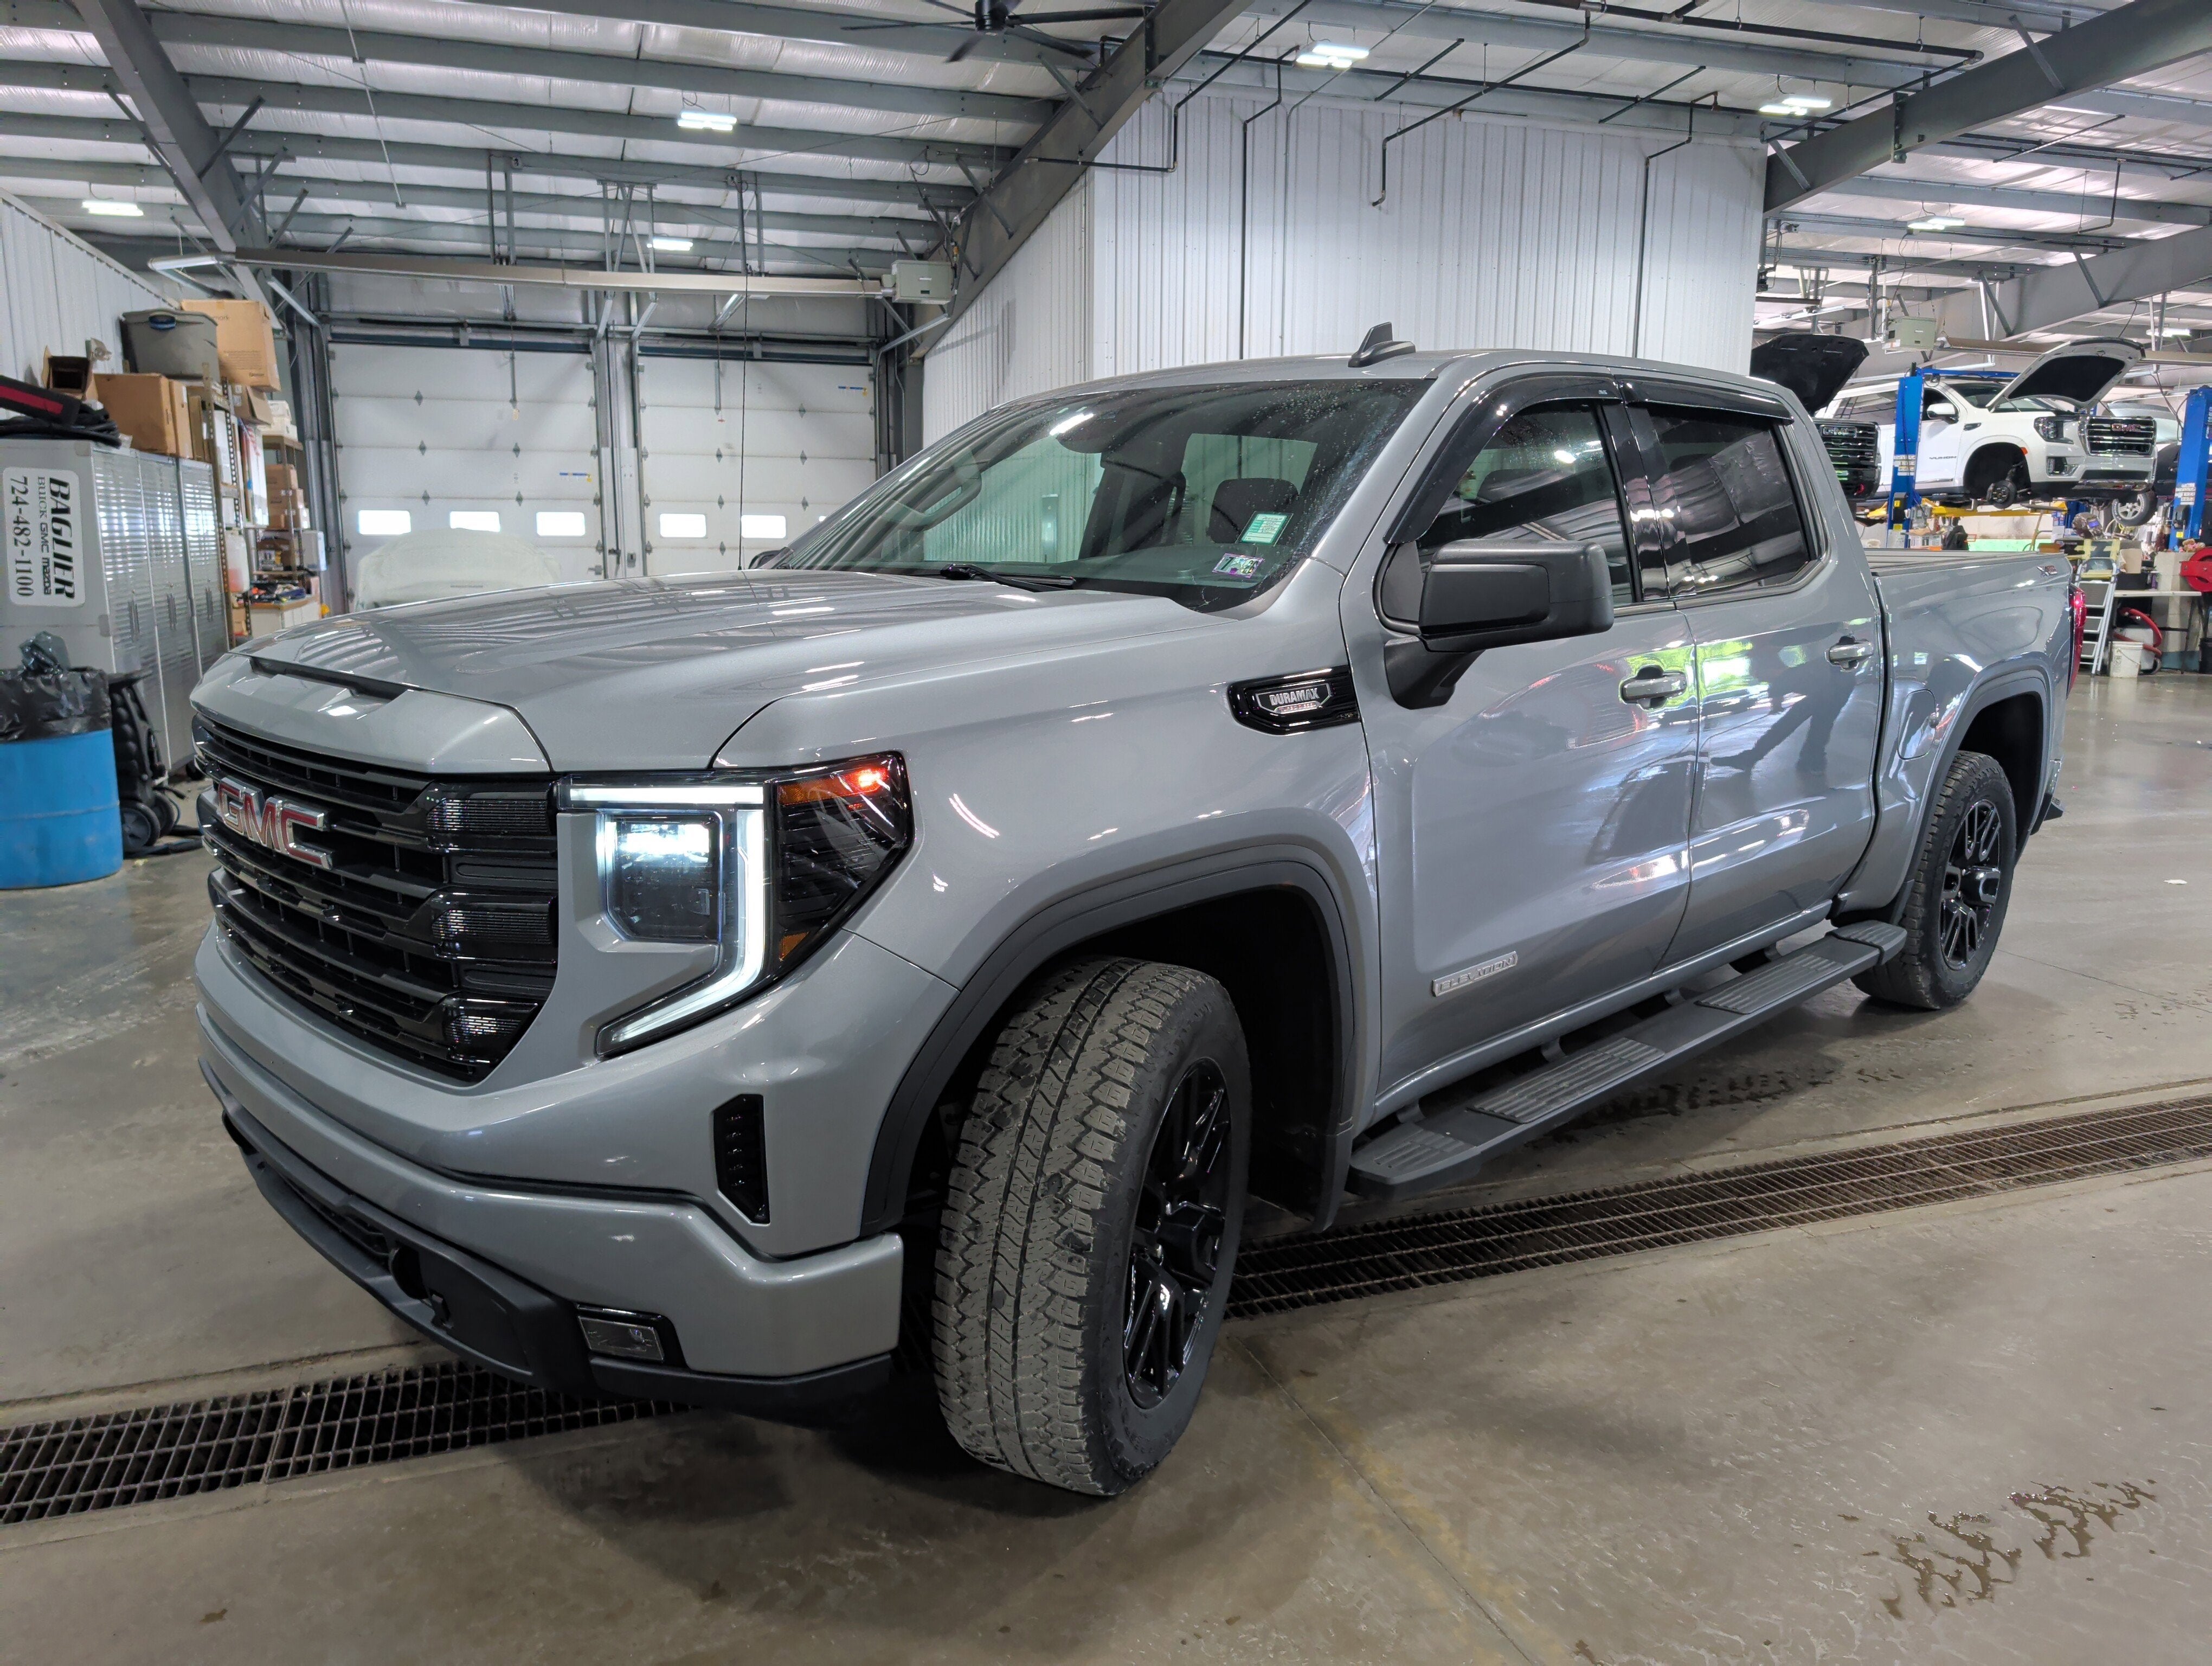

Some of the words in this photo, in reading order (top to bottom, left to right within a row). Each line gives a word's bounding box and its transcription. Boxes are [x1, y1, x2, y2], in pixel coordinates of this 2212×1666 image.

[2111, 423, 2142, 432] GMC
[37, 476, 47, 518] BUICK
[10, 476, 34, 596] 724-482-1100
[40, 523, 49, 553] GMC
[49, 477, 75, 599] BAGLIER
[1269, 688, 1320, 706] DURAMAX
[218, 776, 333, 870] GMC
[1440, 957, 1512, 992] ELEVATION
